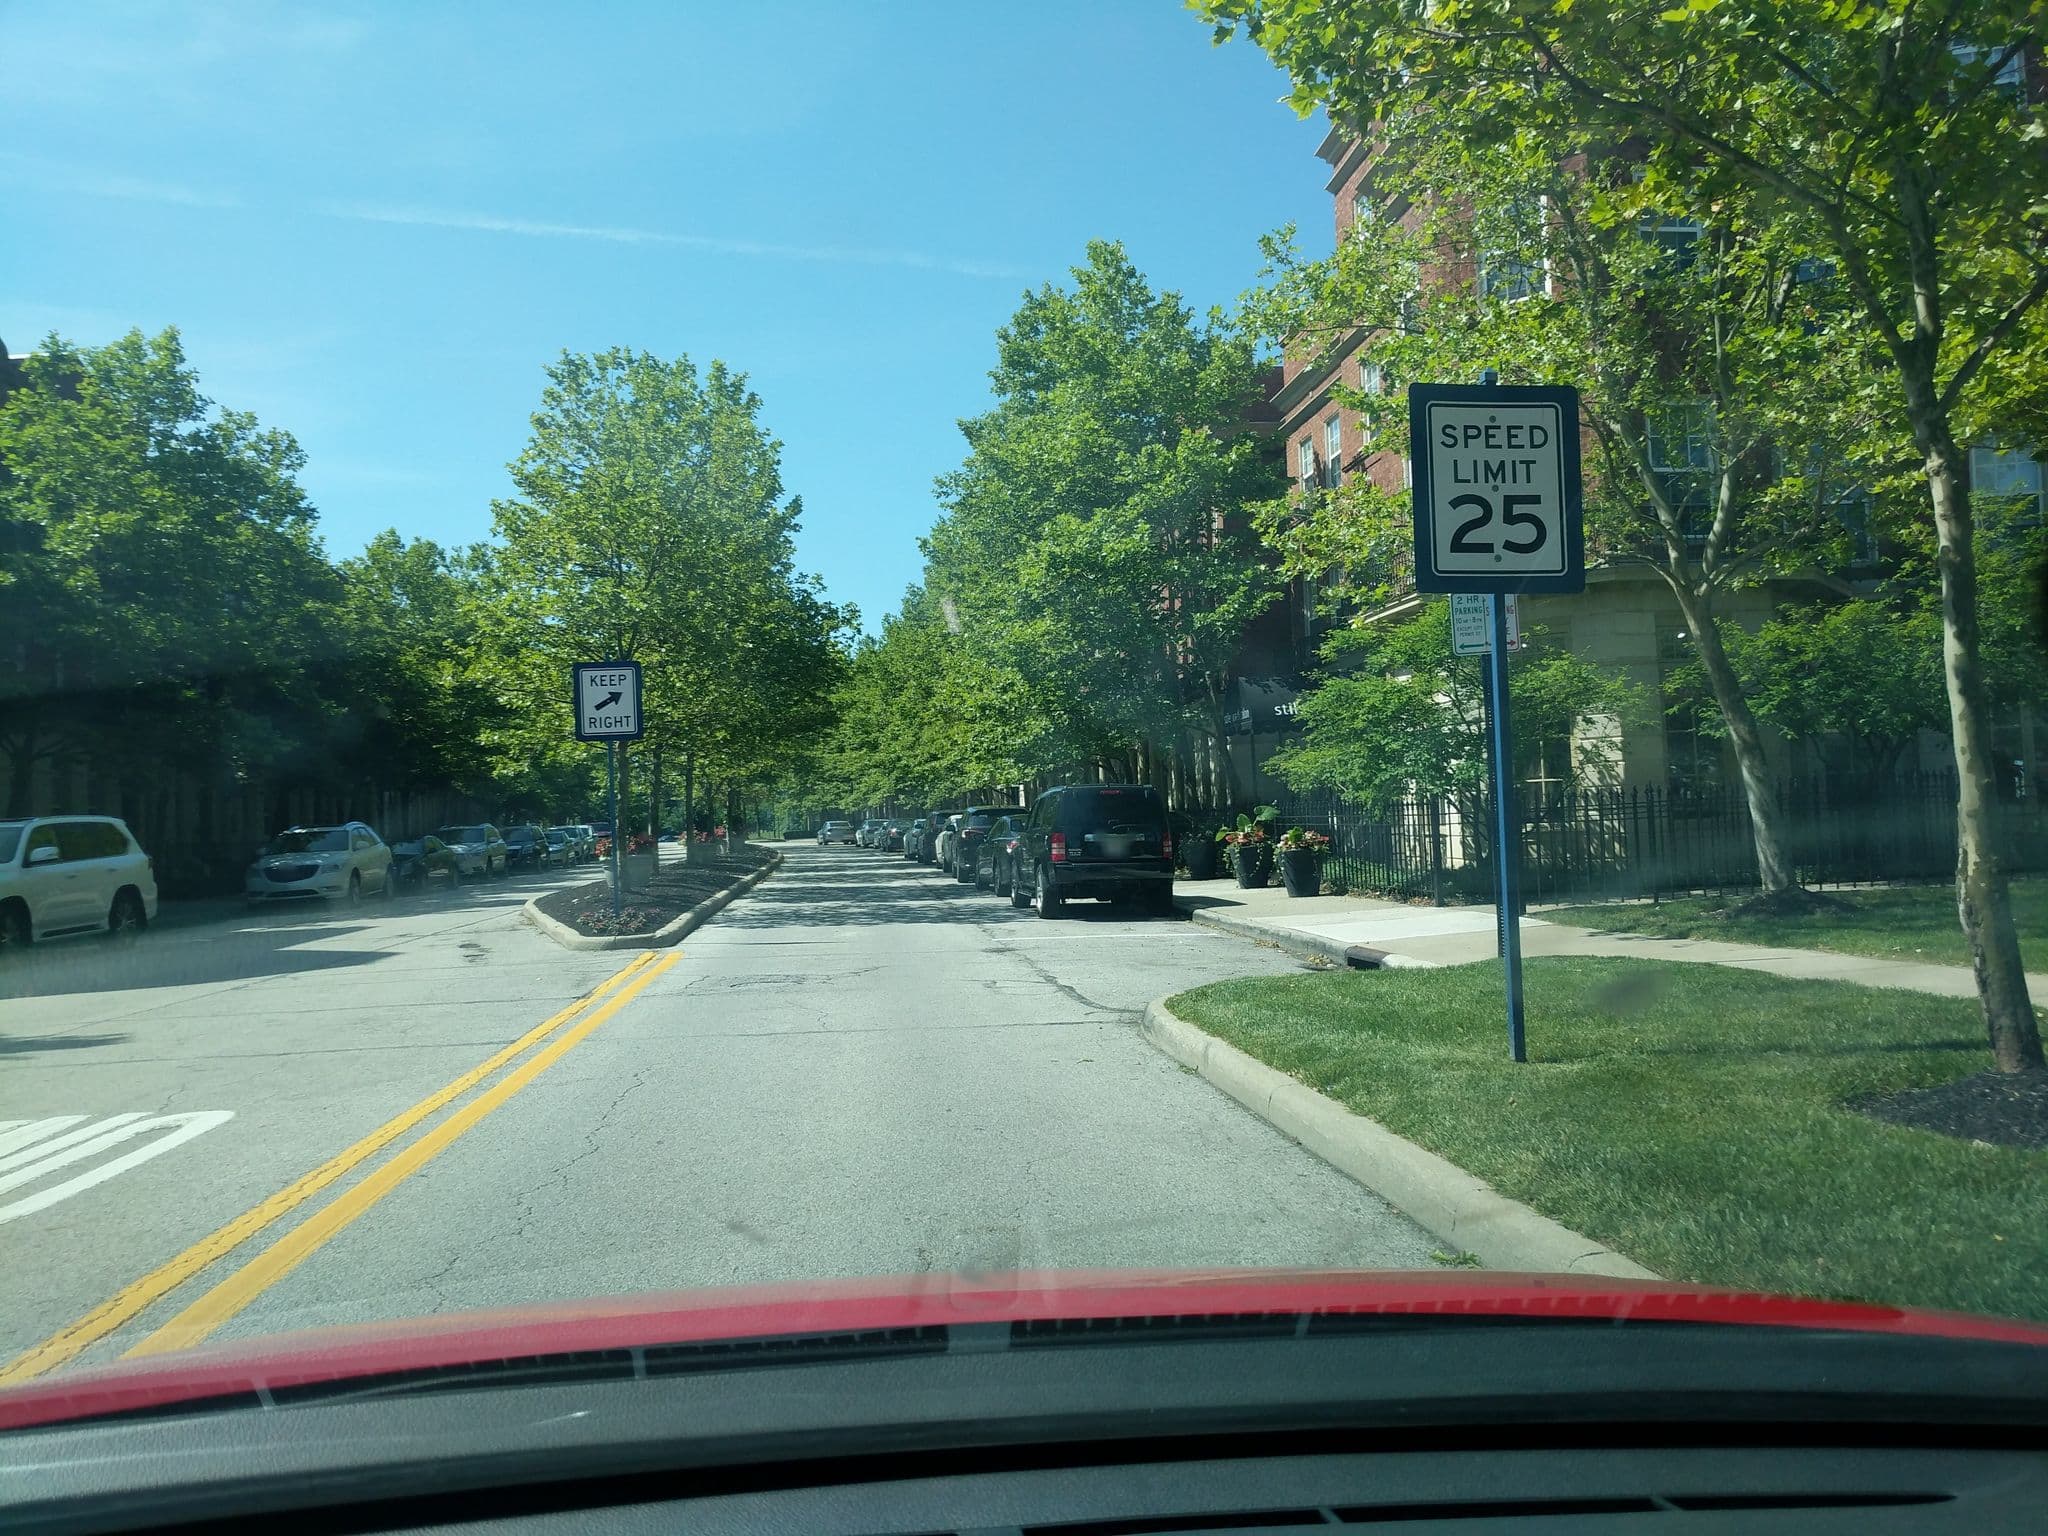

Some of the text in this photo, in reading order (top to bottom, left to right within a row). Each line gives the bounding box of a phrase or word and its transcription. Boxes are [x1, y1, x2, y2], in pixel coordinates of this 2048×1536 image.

[1440, 423, 1549, 450] SPEED
[1453, 459, 1537, 484] LIMIT
[1448, 493, 1547, 554] 25
[1456, 595, 1480, 605] 2 HR
[1454, 605, 1483, 615] PARKING
[590, 674, 627, 687] KEEP
[1274, 702, 1298, 716] stil
[588, 716, 632, 729] RIGHT
